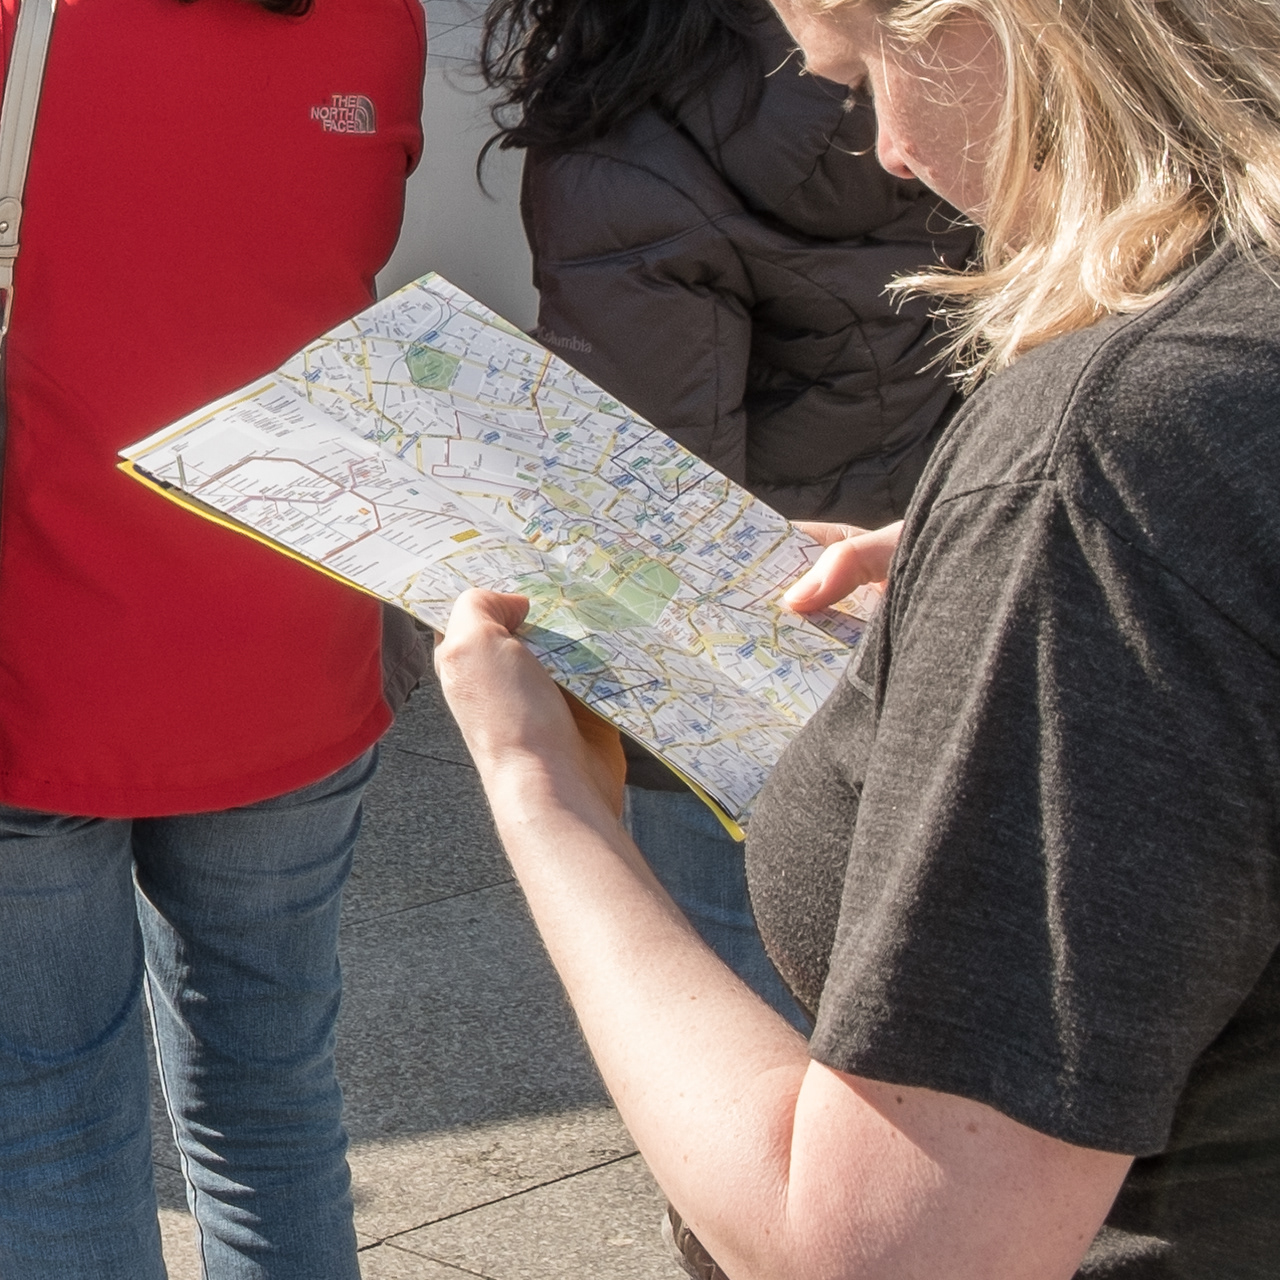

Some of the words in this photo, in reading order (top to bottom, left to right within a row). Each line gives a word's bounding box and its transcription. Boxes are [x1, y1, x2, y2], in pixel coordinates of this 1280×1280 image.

[331, 94, 358, 108] THE
[310, 106, 355, 120] NORTH
[322, 120, 355, 133] FACE
